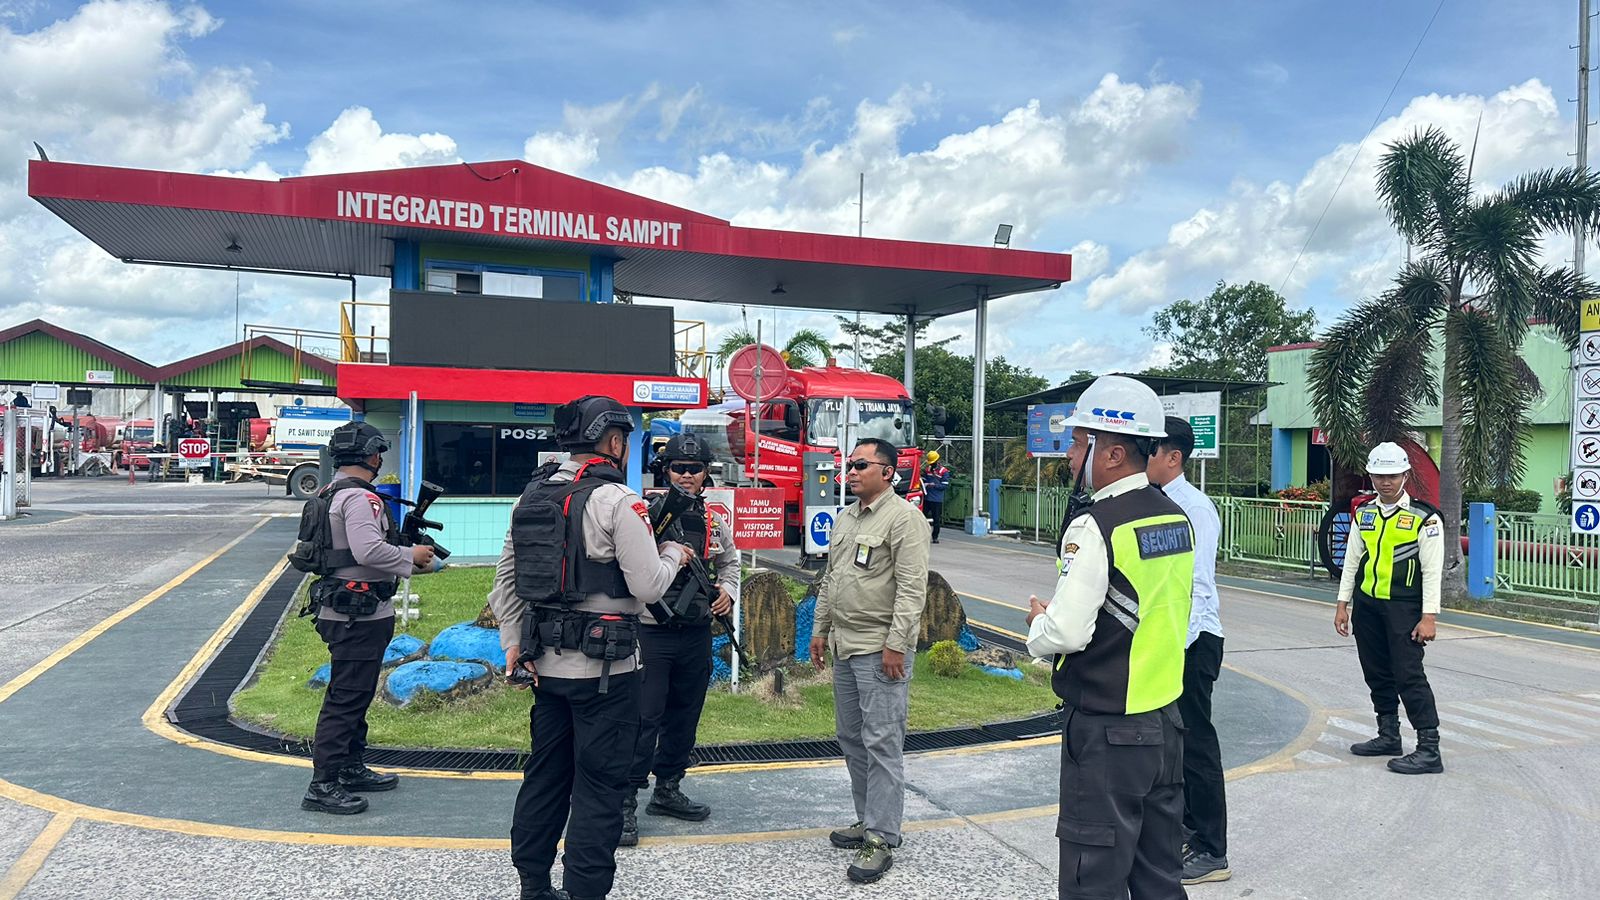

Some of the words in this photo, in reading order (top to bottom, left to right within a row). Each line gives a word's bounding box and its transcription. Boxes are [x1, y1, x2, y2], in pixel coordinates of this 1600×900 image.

[337, 190, 485, 229] INTEGRATED
[489, 205, 600, 241] TERMINAL
[606, 216, 682, 246] SAMPIT
[88, 371, 95, 380] 6
[825, 401, 835, 411] PT.
[864, 402, 886, 412] TRIANA
[887, 403, 901, 413] JAYA
[1105, 417, 1128, 426] SAMPIT
[288, 428, 296, 436] PT.
[297, 428, 316, 437] SAWIT
[500, 428, 548, 440] POS2
[180, 442, 209, 454] STOP
[750, 499, 770, 507] TAMU
[736, 506, 758, 514] WAJIB
[735, 530, 755, 538] MUST
[755, 530, 782, 538] REPORT
[1141, 526, 1189, 554] SECURITY
